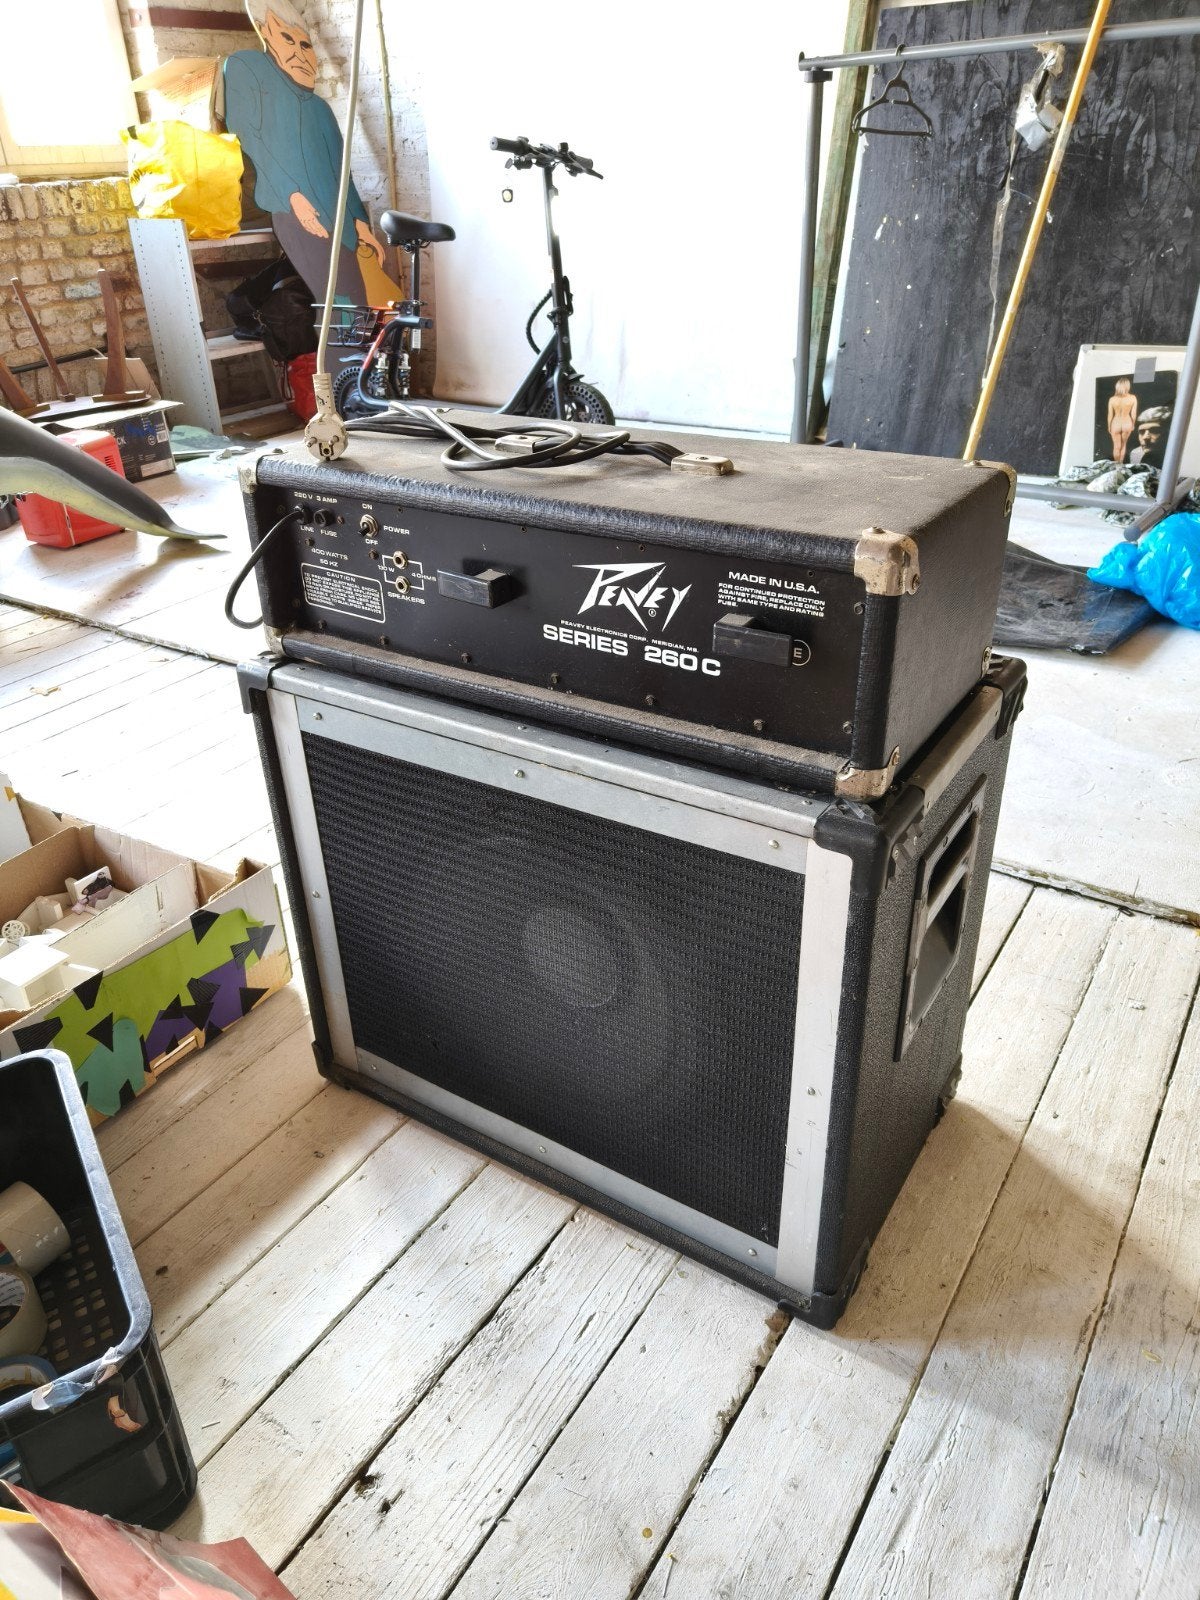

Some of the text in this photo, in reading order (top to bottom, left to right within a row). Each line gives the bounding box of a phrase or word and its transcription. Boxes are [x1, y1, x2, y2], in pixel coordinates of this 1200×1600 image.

[320, 529, 338, 537] FUSE
[383, 525, 410, 535] POWER
[326, 571, 356, 582] CAUTION
[728, 571, 820, 594] MADE IN U.S.A.
[388, 591, 426, 604] SPEAKERS
[572, 562, 692, 632] PEAVEY
[718, 588, 825, 612] AGAINST FIRE, REPLACE ONLY
[734, 585, 776, 597] CONTINUED
[778, 593, 826, 606] PROTECTION
[737, 597, 758, 605] SAME
[759, 601, 778, 609] TYPE
[779, 604, 795, 612] AND
[796, 606, 824, 617] RATING
[560, 619, 586, 629] PEAVEY
[586, 625, 628, 638] ELECTRONICS
[629, 633, 649, 643] CORP.
[652, 639, 686, 651] MERIDIAN,
[543, 624, 721, 677] SERIES 260 C
